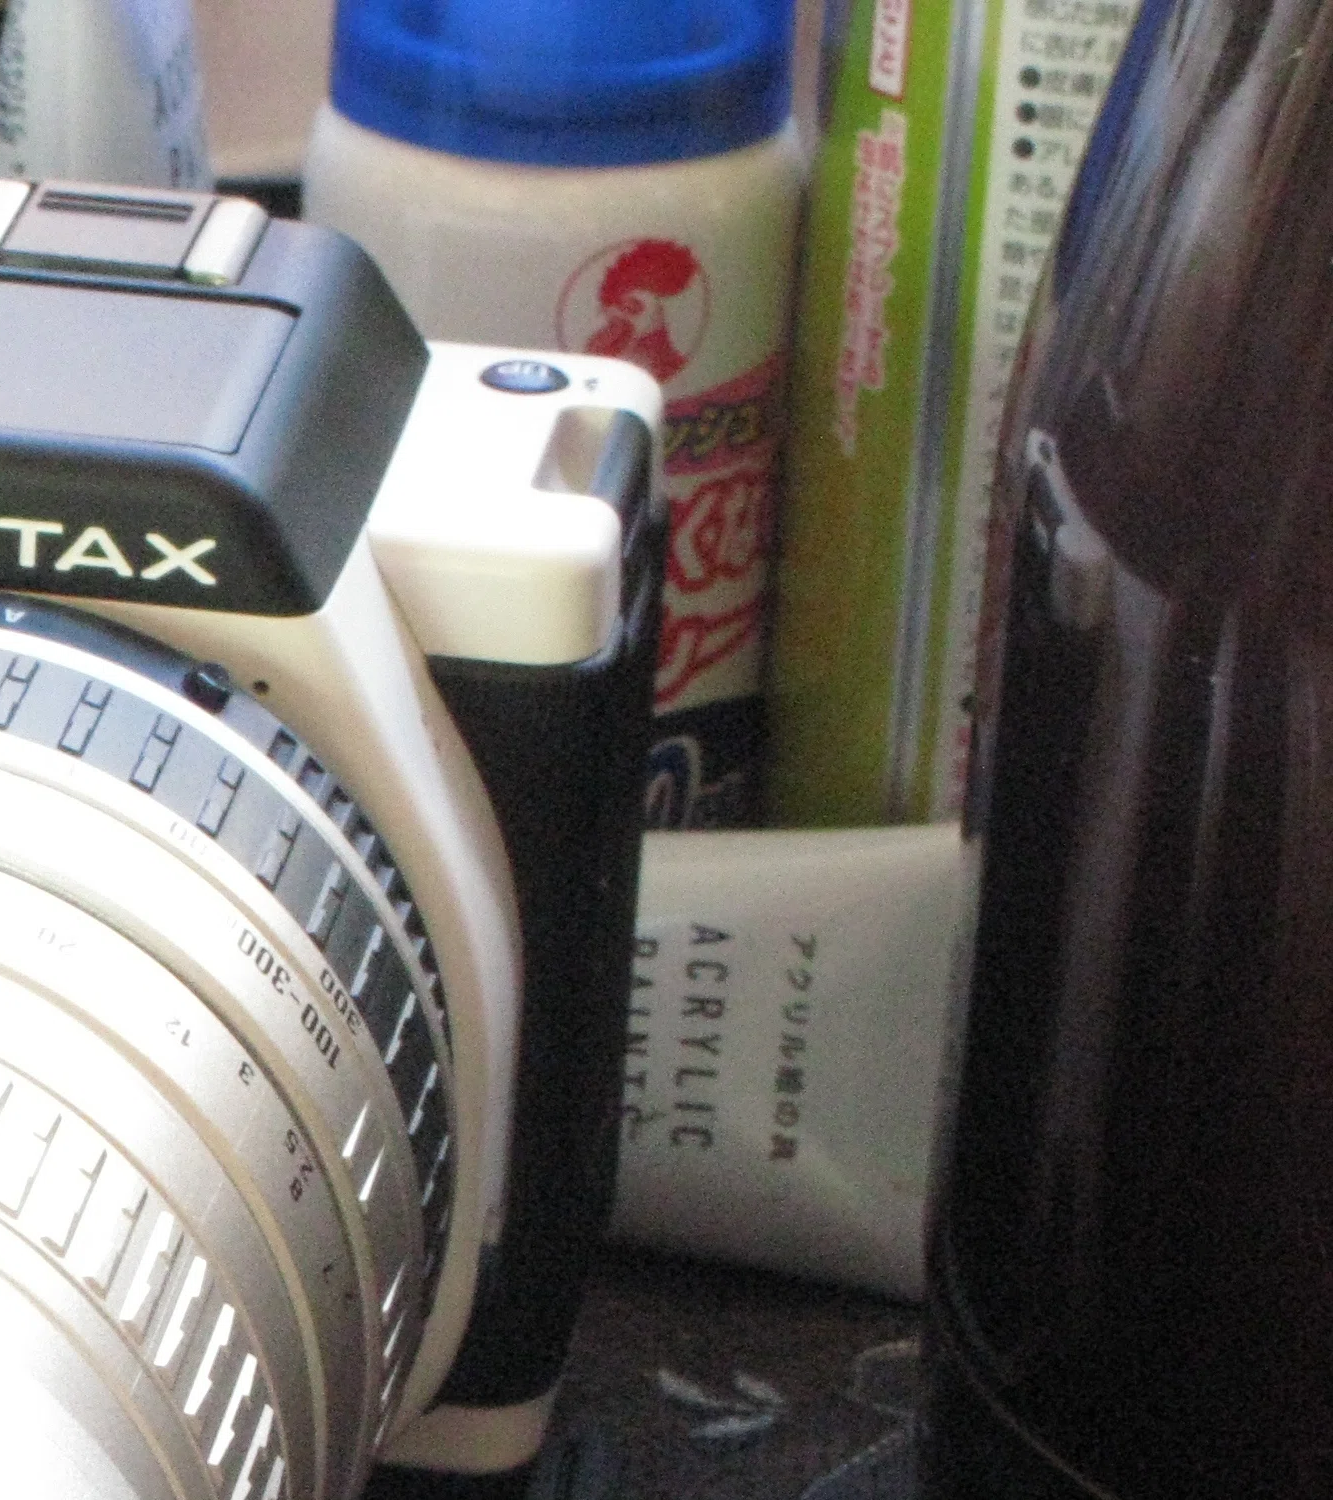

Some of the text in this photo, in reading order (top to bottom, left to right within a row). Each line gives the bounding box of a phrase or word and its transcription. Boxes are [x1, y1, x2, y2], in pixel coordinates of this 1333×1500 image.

[236, 928, 340, 1070] 100-300
[319, 967, 362, 1037] 300
[670, 922, 731, 1149] ACRYLIC
[769, 934, 817, 1162] アクリル絵の具
[237, 1060, 256, 1087] 3
